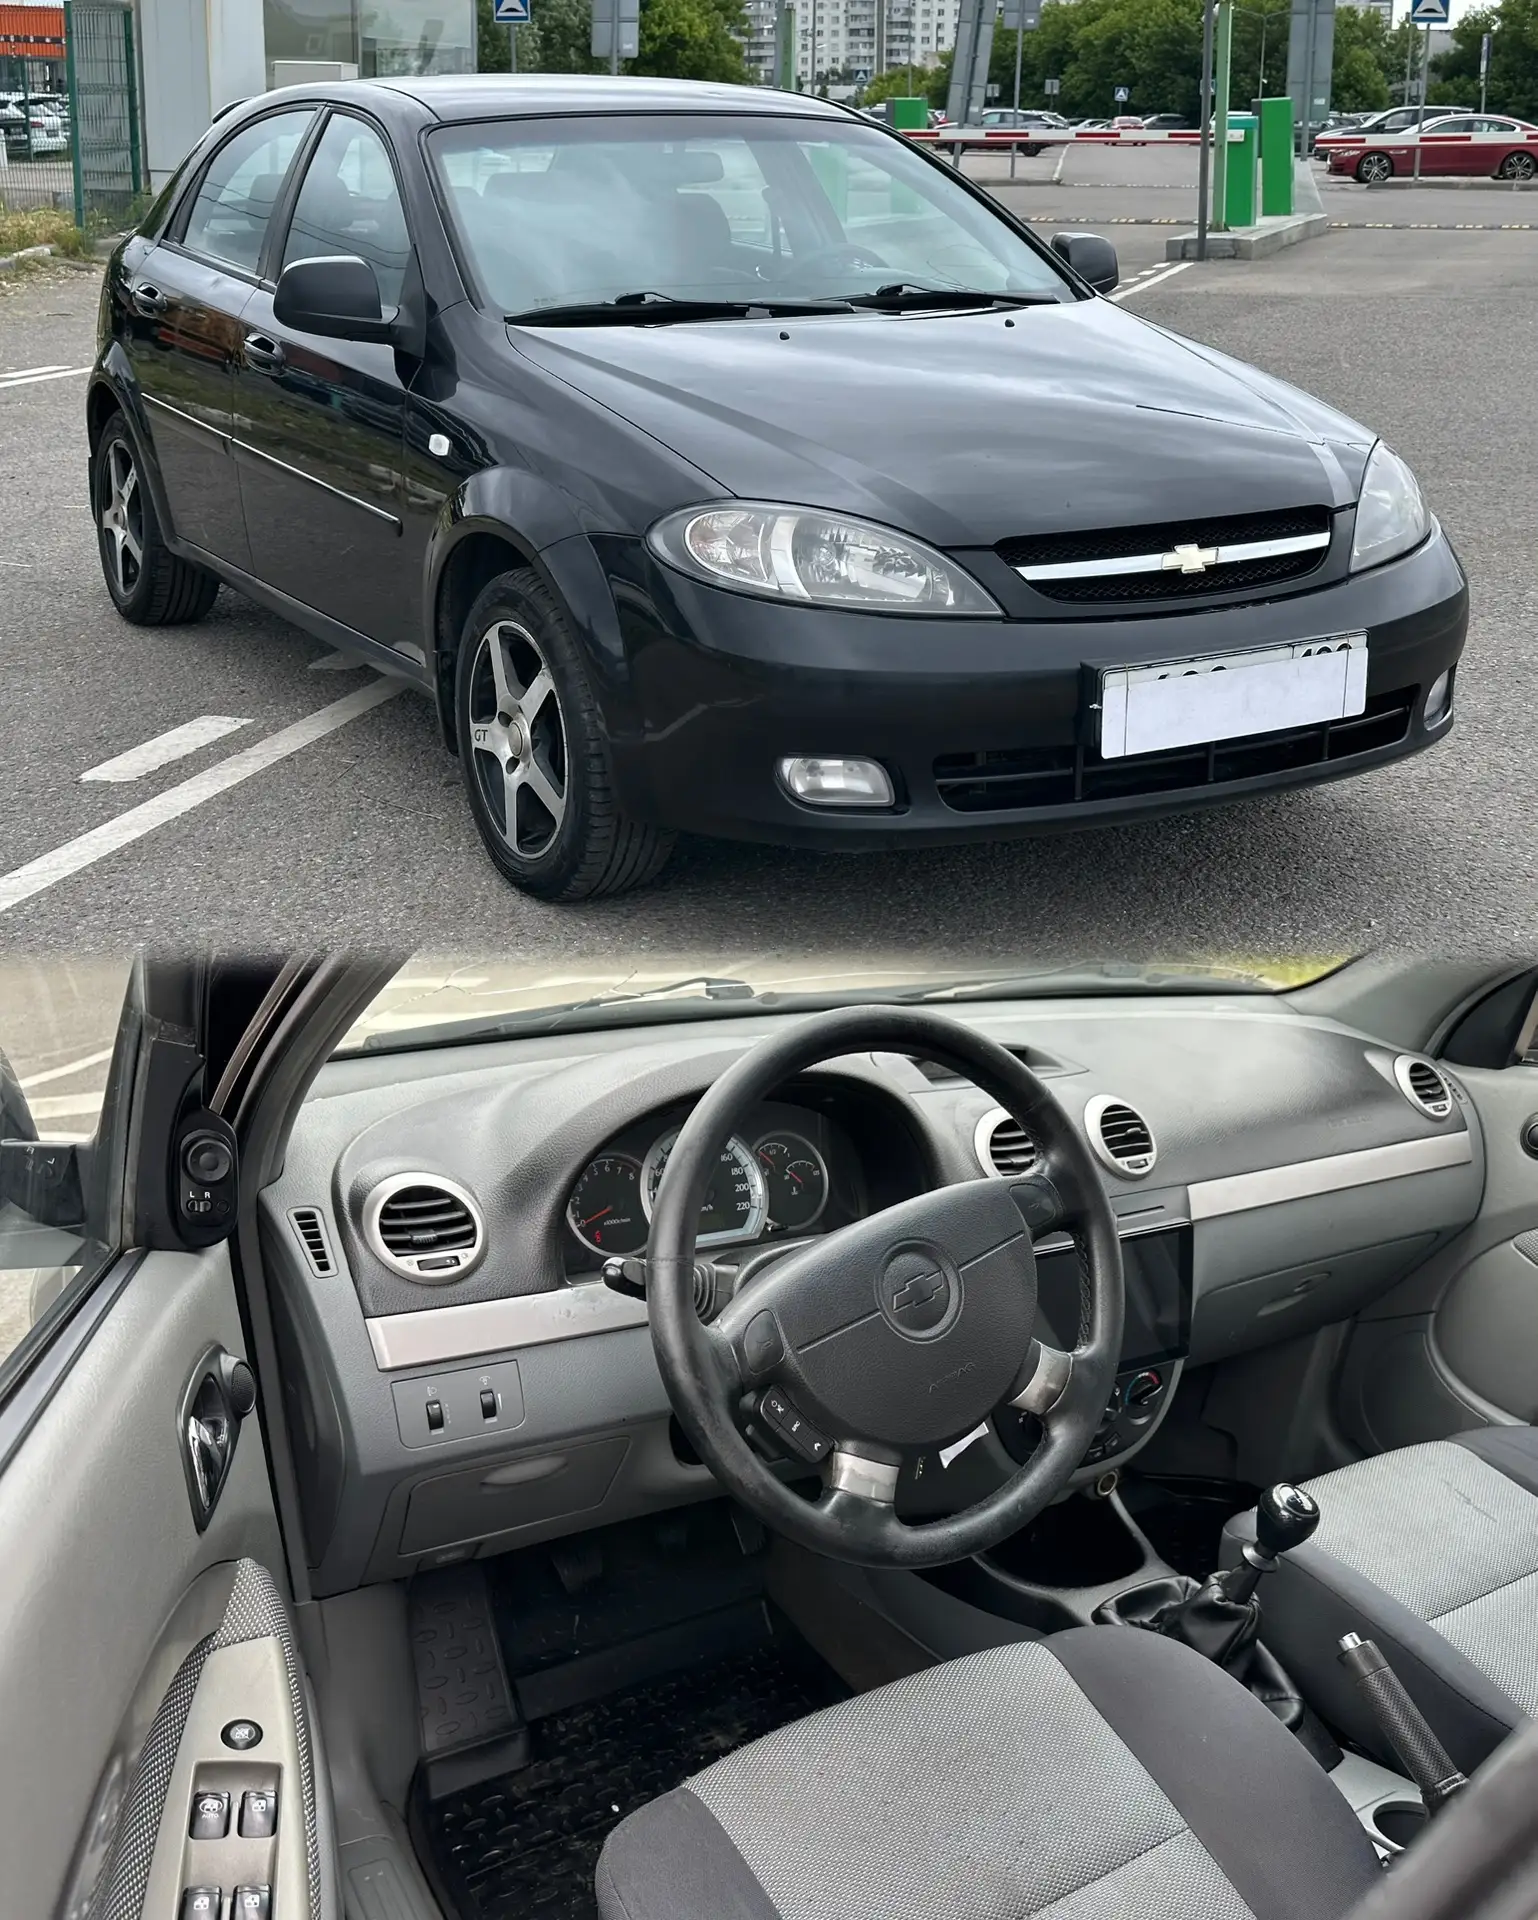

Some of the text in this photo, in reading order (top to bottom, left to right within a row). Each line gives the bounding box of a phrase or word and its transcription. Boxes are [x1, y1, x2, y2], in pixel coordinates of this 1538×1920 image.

[474, 728, 489, 743] GT
[720, 1153, 733, 1162] 160
[616, 1166, 622, 1175] 7
[731, 1167, 744, 1176] 180
[628, 1172, 635, 1181] 8
[734, 1183, 750, 1192] 200
[189, 1190, 211, 1199] L R
[574, 1197, 580, 1205] 2
[700, 1204, 714, 1212] m/h
[736, 1202, 750, 1211] 220
